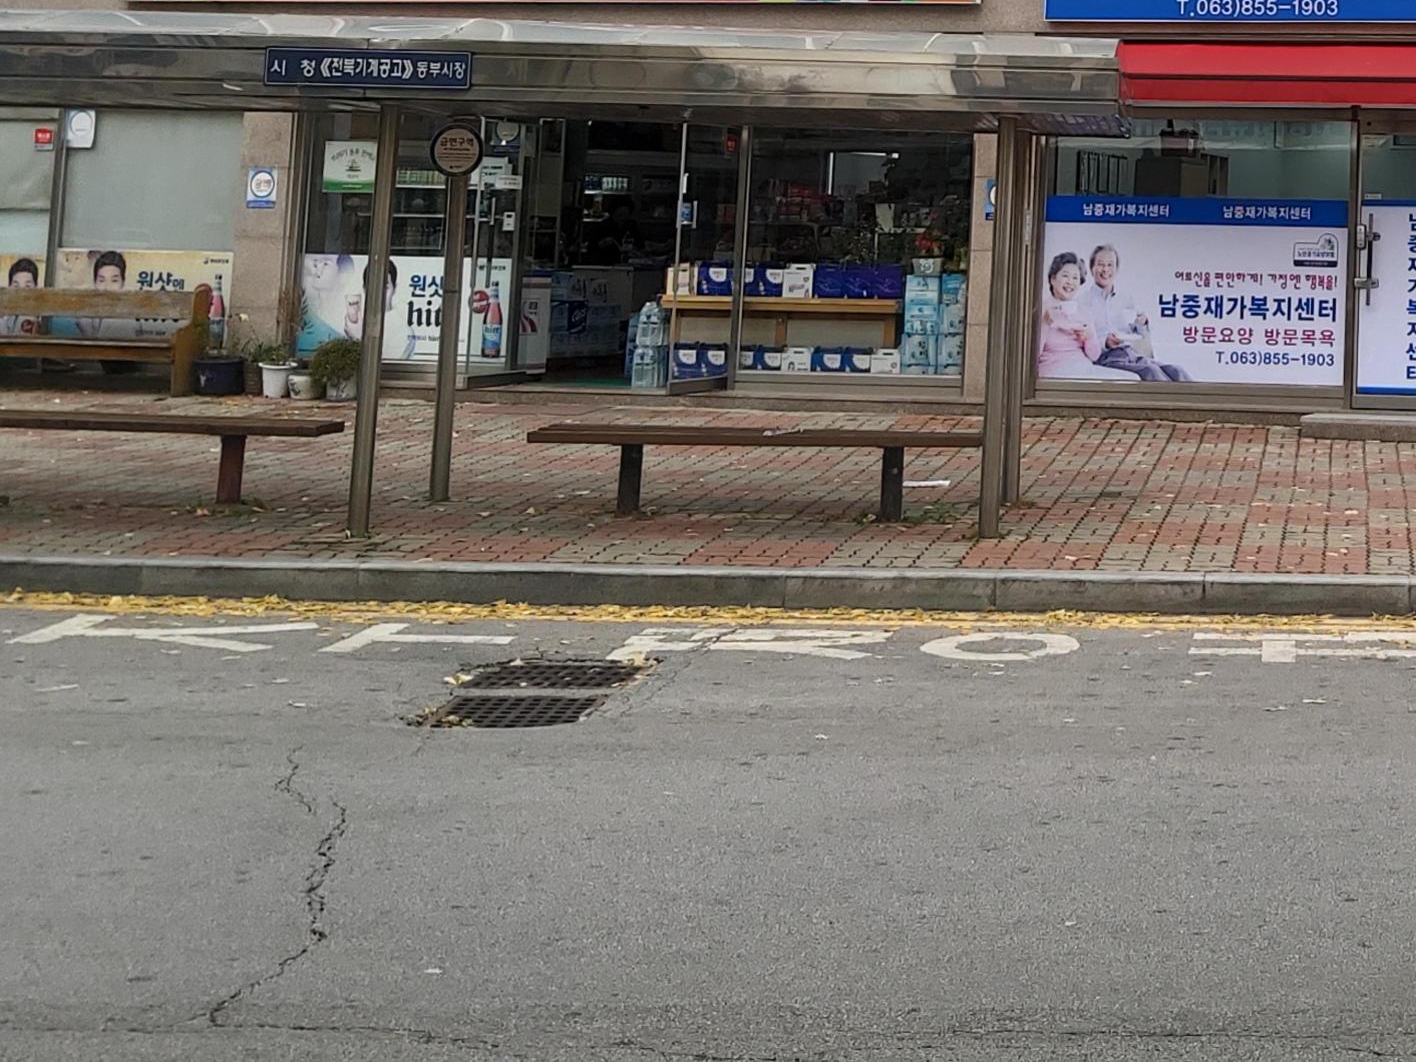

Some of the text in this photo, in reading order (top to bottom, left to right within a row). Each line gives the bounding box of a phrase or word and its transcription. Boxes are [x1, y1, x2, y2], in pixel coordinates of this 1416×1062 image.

[416, 61, 465, 79] 동부시장
[1082, 203, 1170, 218] 남중재가복지센터
[1222, 205, 1312, 220] 남중재가복지센터
[1174, 271, 1211, 288] 어르신을
[1267, 273, 1302, 289] 가정엔
[1158, 293, 1337, 323] 남중재가복지센터
[1183, 326, 1336, 348] 방문요양 방문목욕
[1216, 350, 1335, 368] T.063)855-1903
